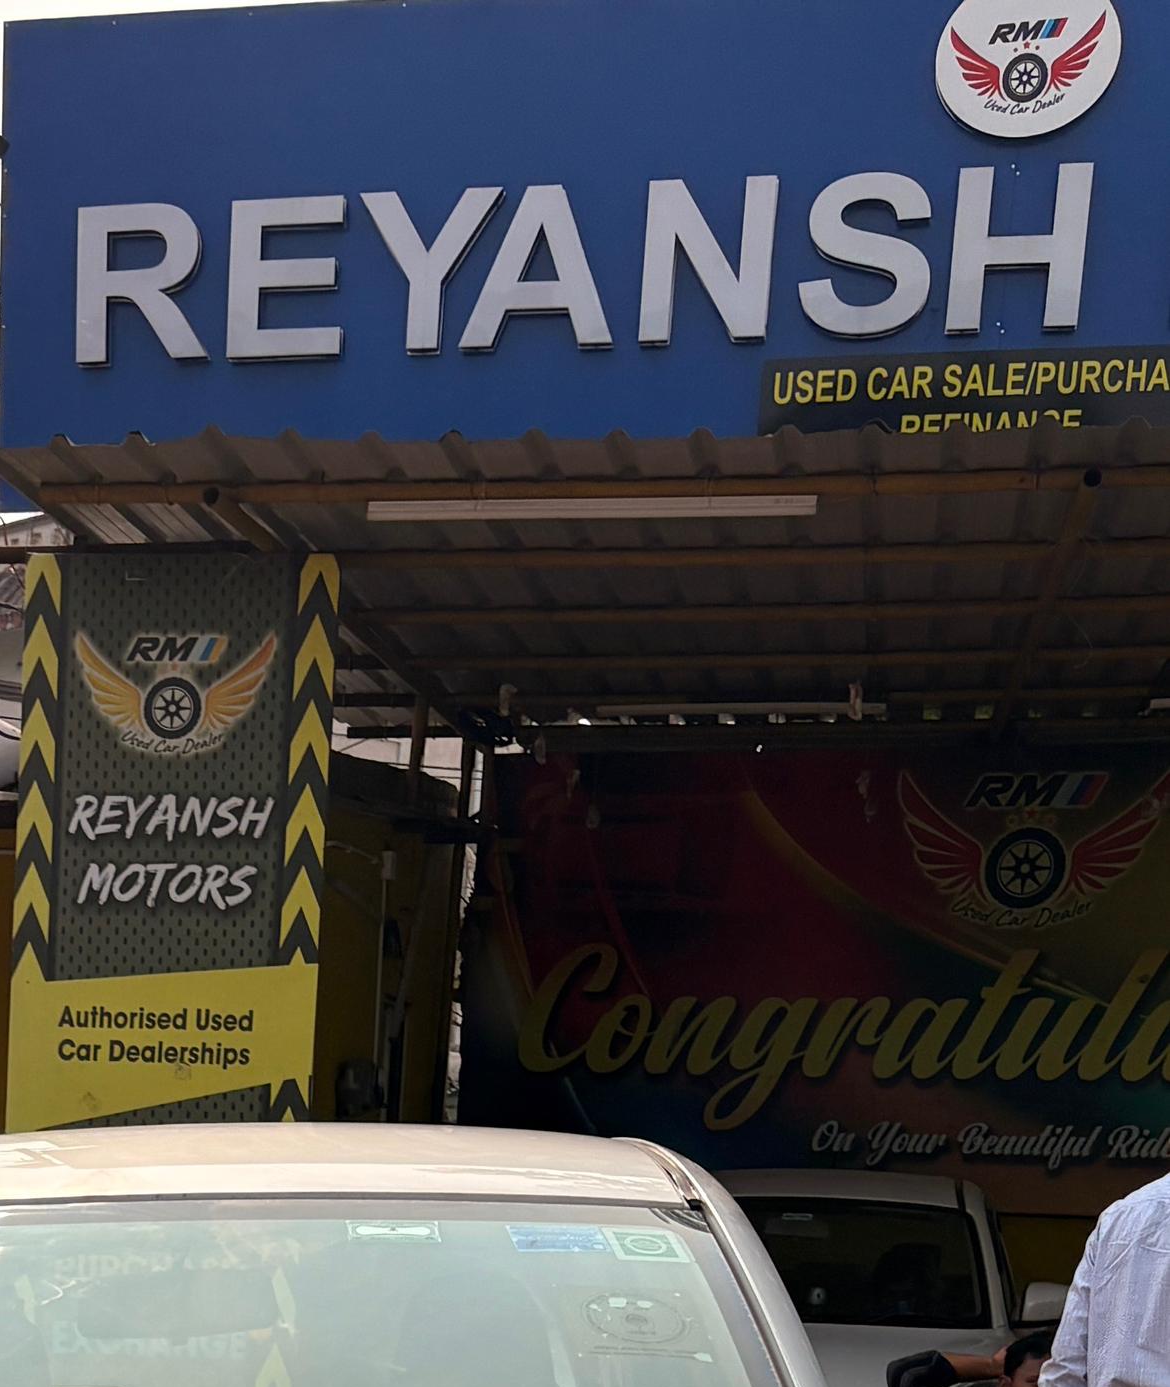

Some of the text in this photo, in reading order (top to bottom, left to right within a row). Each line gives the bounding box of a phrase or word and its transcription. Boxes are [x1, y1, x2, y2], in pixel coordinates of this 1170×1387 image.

[983, 92, 1066, 115] Used Car Dealer
[75, 163, 1097, 368] REYANSH
[774, 368, 857, 405] USED
[866, 365, 932, 400] CAR
[901, 408, 1083, 434] REFNANE
[121, 730, 222, 754] Used Car Dealer
[68, 794, 274, 842] REYANSH
[77, 862, 258, 911] MOTORS
[952, 901, 1091, 928] Used Car Dealer
[58, 1005, 254, 1032] Authorised Used
[58, 1039, 250, 1070] Car Dealerships
[812, 1121, 855, 1152] On
[867, 1121, 946, 1166] Your
[958, 1123, 1103, 1170] Beautiful
